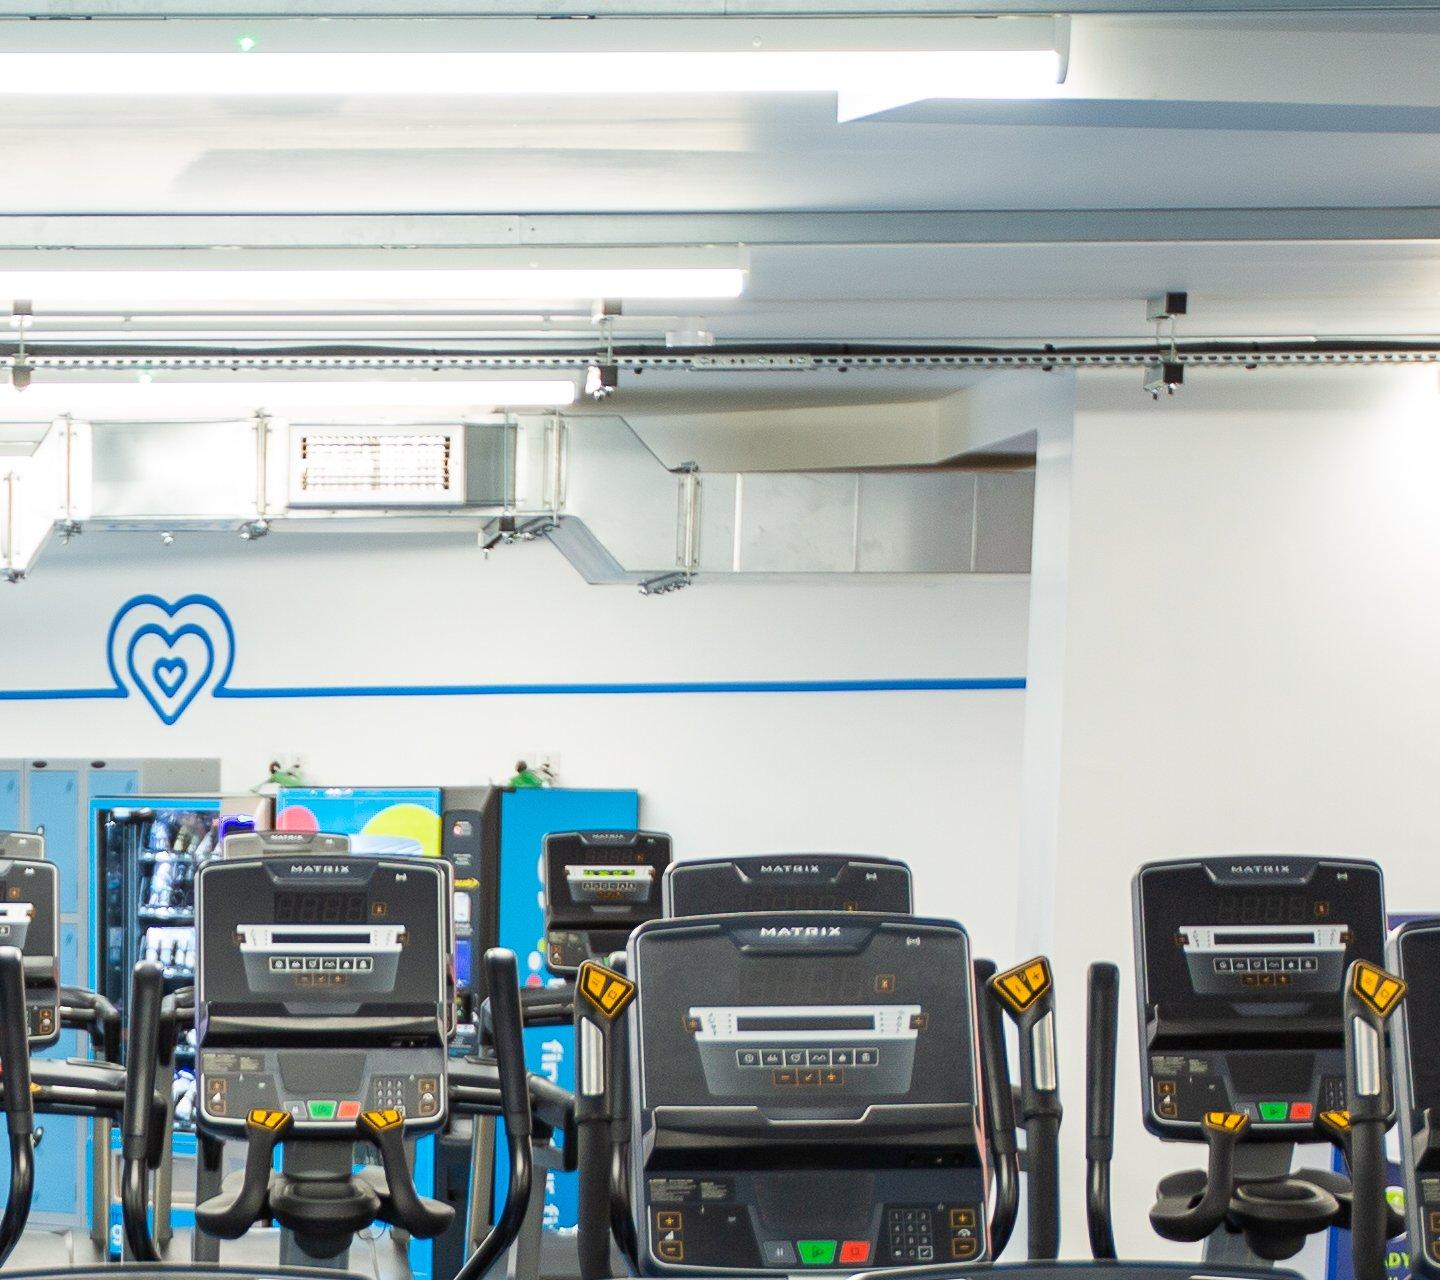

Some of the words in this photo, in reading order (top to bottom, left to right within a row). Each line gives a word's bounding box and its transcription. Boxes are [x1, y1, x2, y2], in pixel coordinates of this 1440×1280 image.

[290, 865, 350, 873] MATRIX
[760, 864, 820, 873] MATRIX
[1230, 865, 1290, 874] MATRIX
[759, 926, 841, 938] MATRIX
